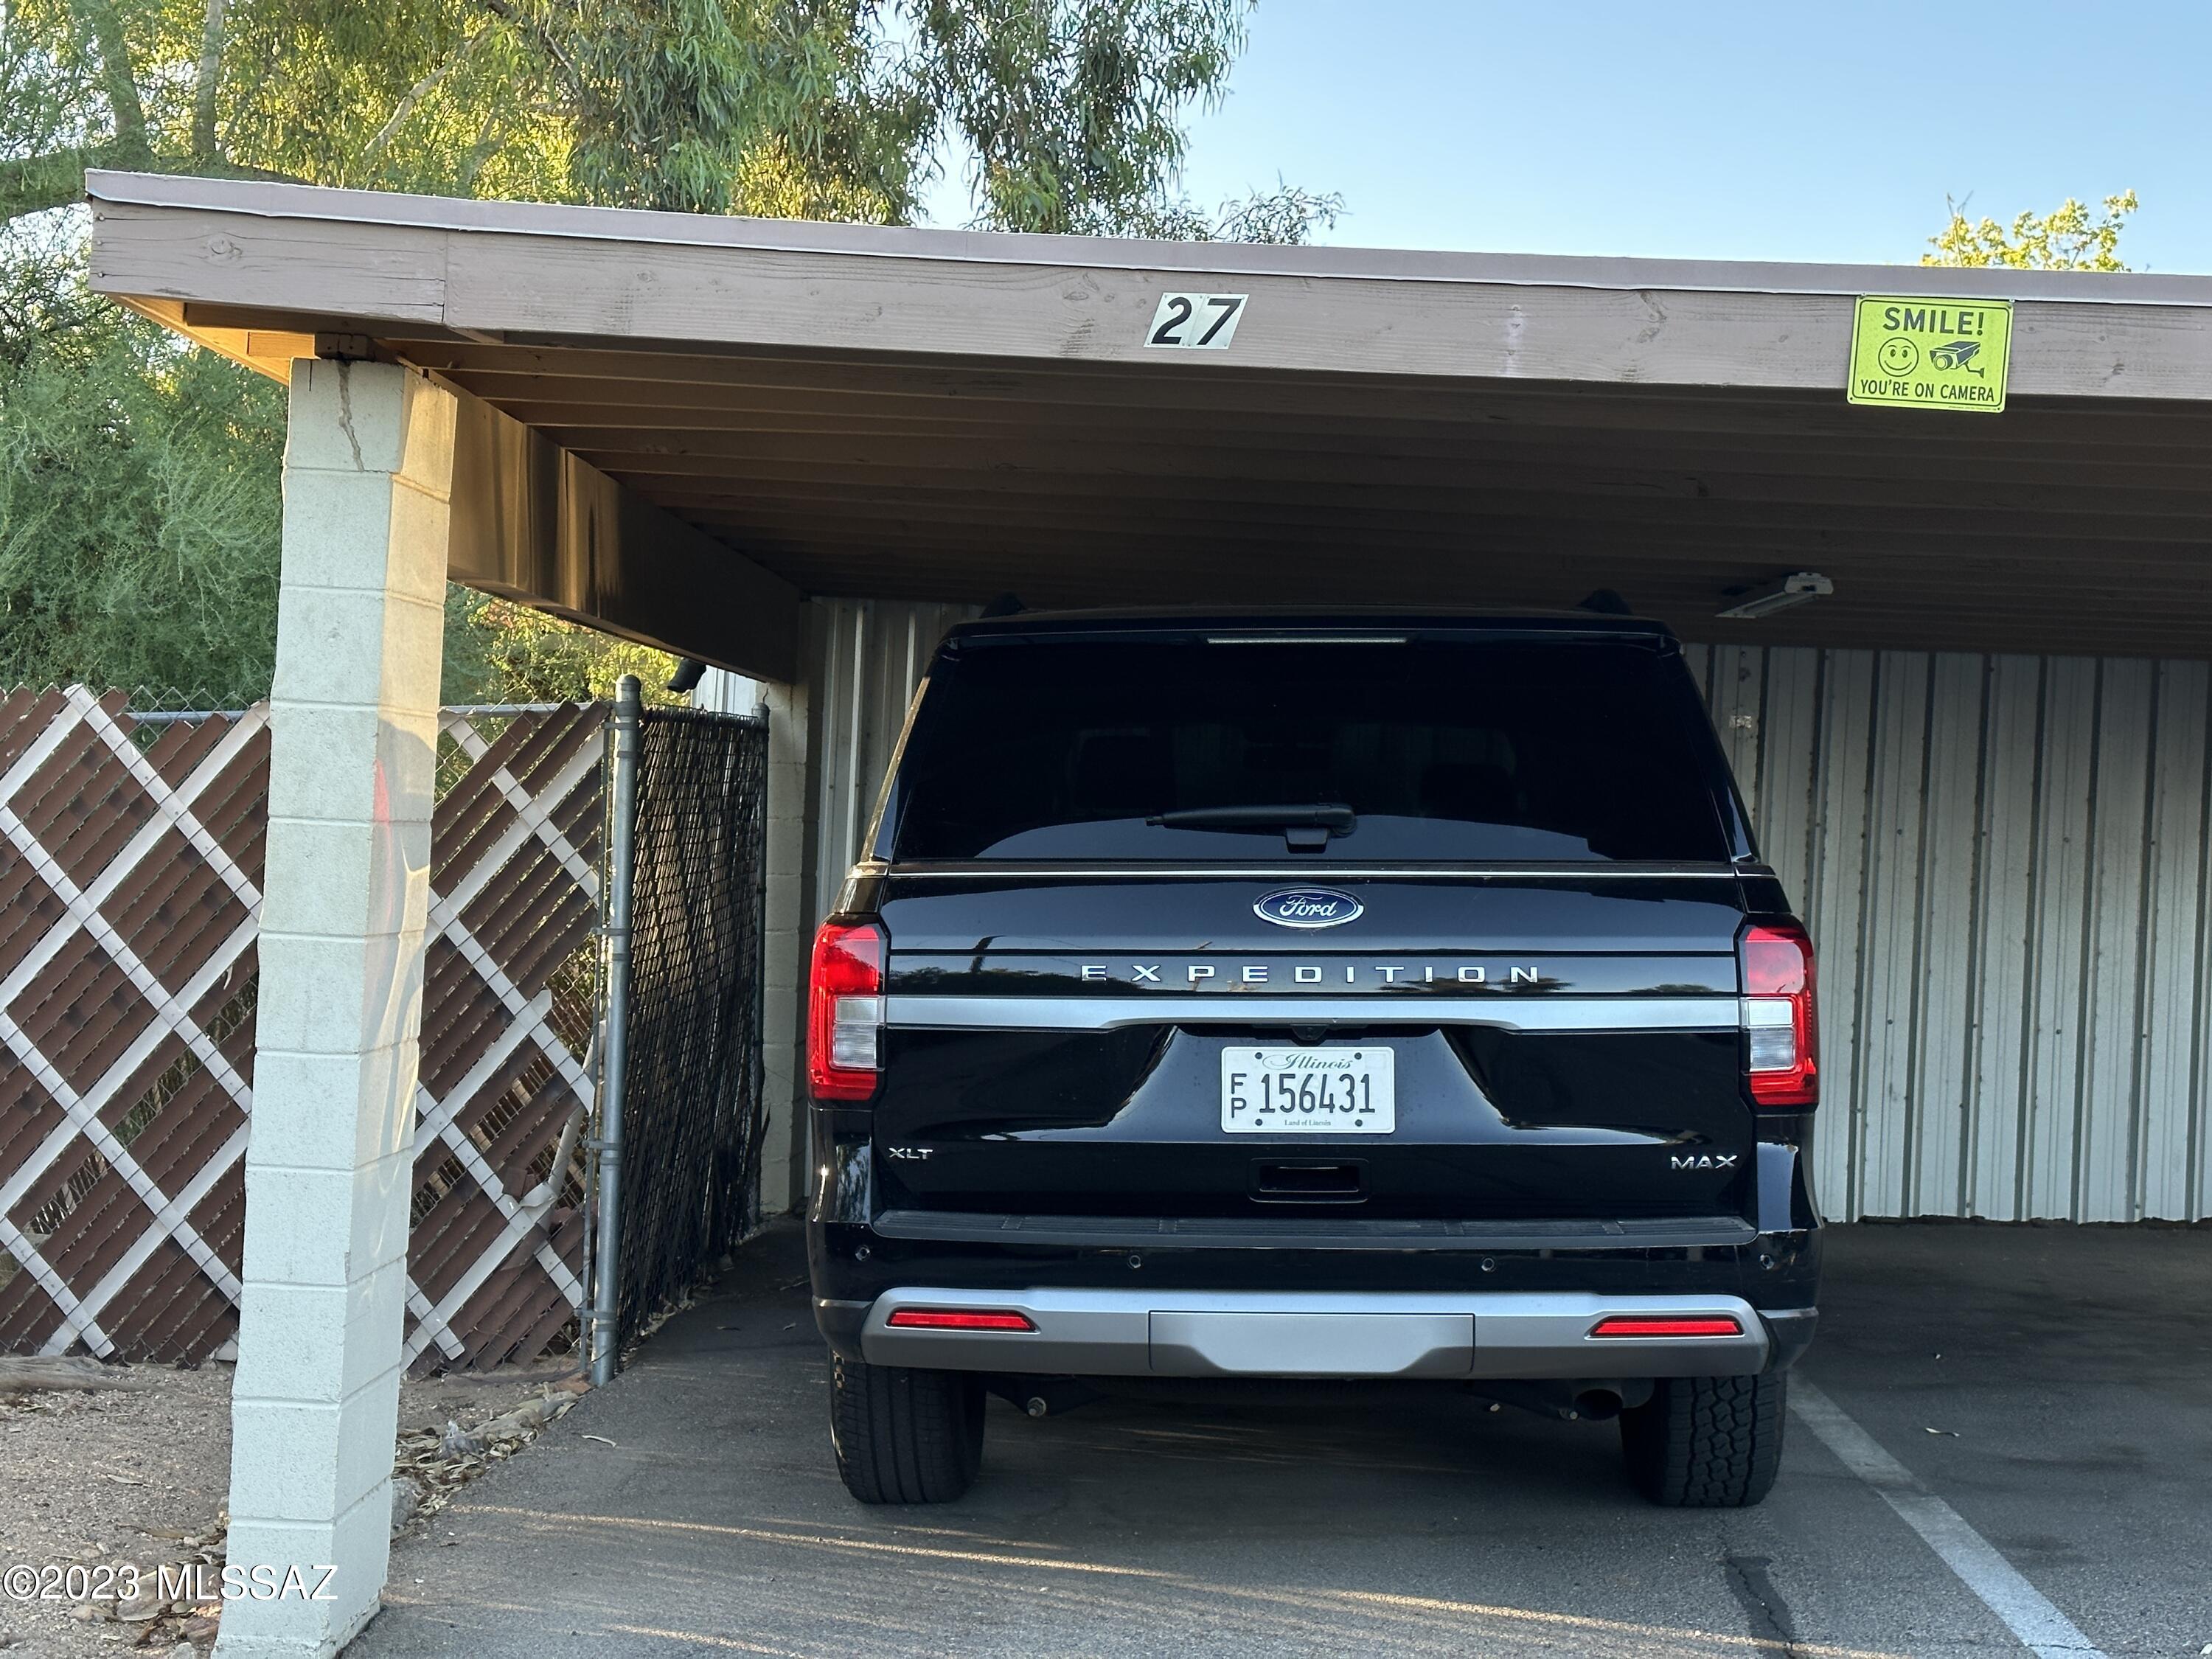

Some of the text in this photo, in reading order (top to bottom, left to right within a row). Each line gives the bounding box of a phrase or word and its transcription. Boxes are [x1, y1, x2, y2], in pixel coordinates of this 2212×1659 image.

[1151, 296, 1242, 345] 27
[1882, 307, 1984, 336] SMILE!
[1860, 379, 1994, 402] YOU'RE ON CAMERA
[1279, 894, 1338, 917] Ford
[1080, 964, 1539, 984] EXPEDITION
[1262, 1052, 1353, 1070] Illinois
[1259, 1074, 1376, 1113] 156431
[888, 1147, 933, 1160] XLT
[1671, 1155, 1738, 1169] MAX
